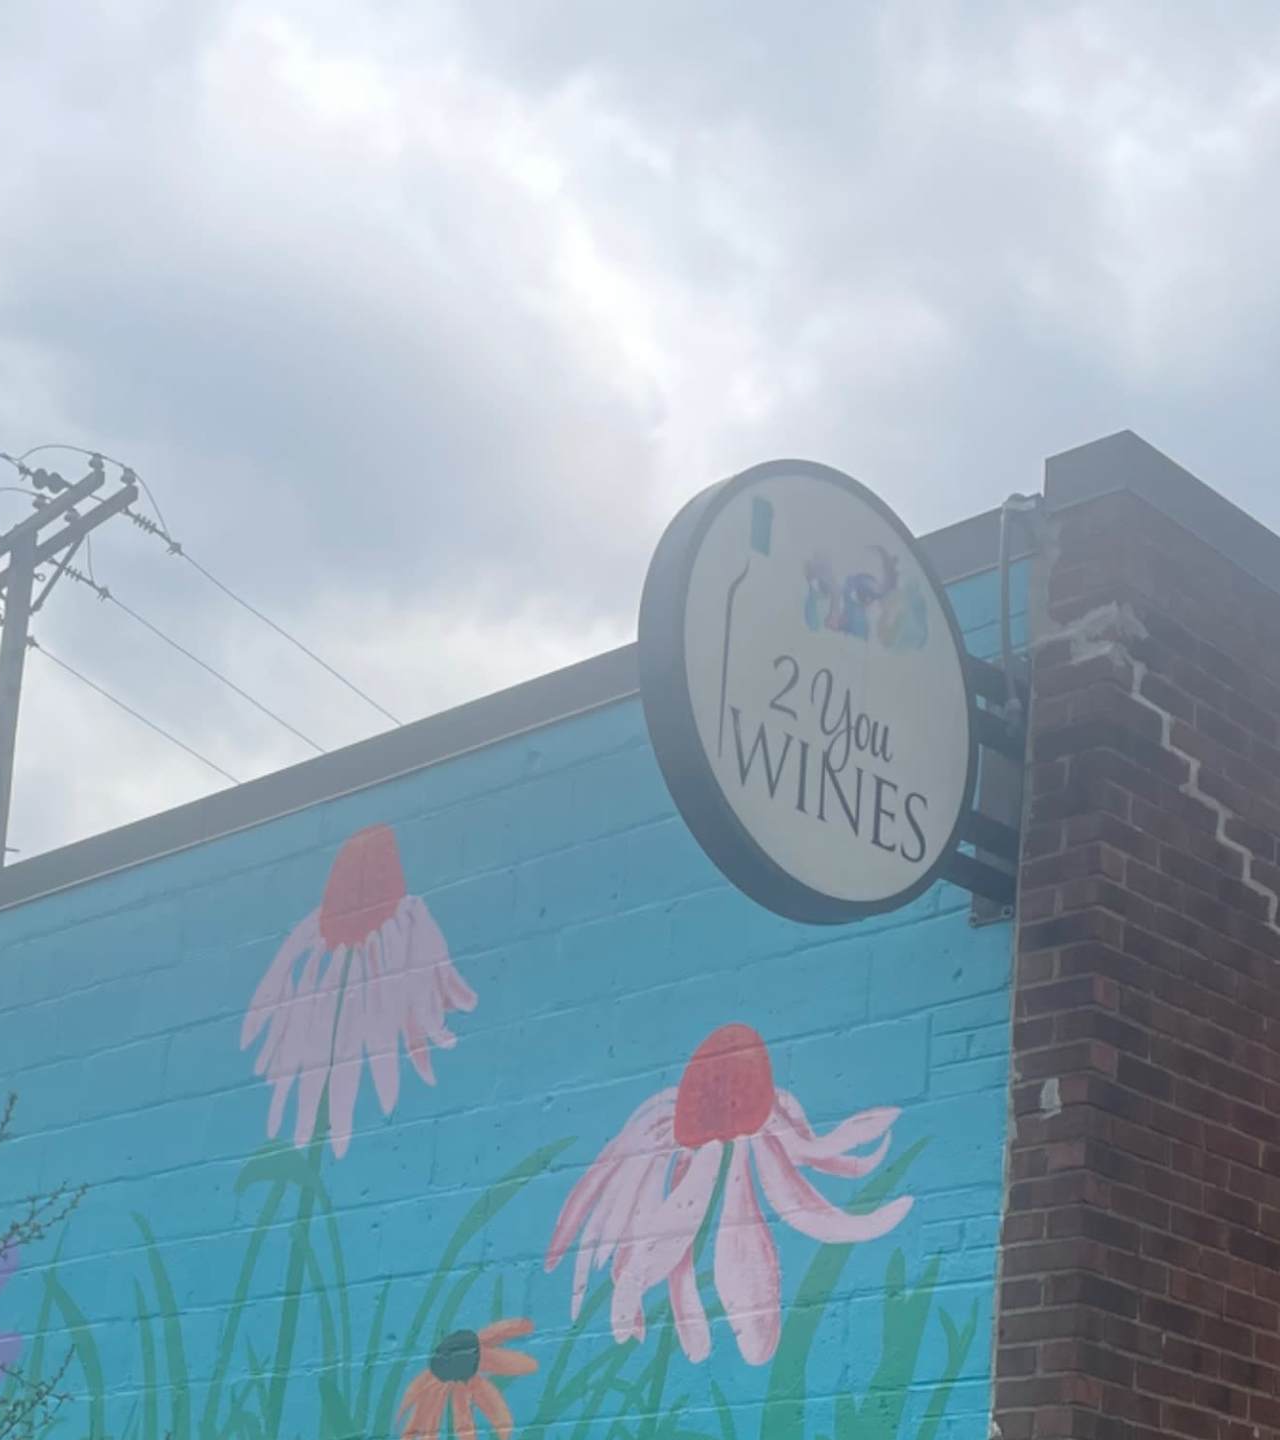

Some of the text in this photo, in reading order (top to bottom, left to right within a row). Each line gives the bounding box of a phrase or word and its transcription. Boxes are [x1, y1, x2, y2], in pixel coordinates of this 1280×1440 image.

[768, 654, 894, 770] 2 You
[730, 705, 929, 865] WINES
